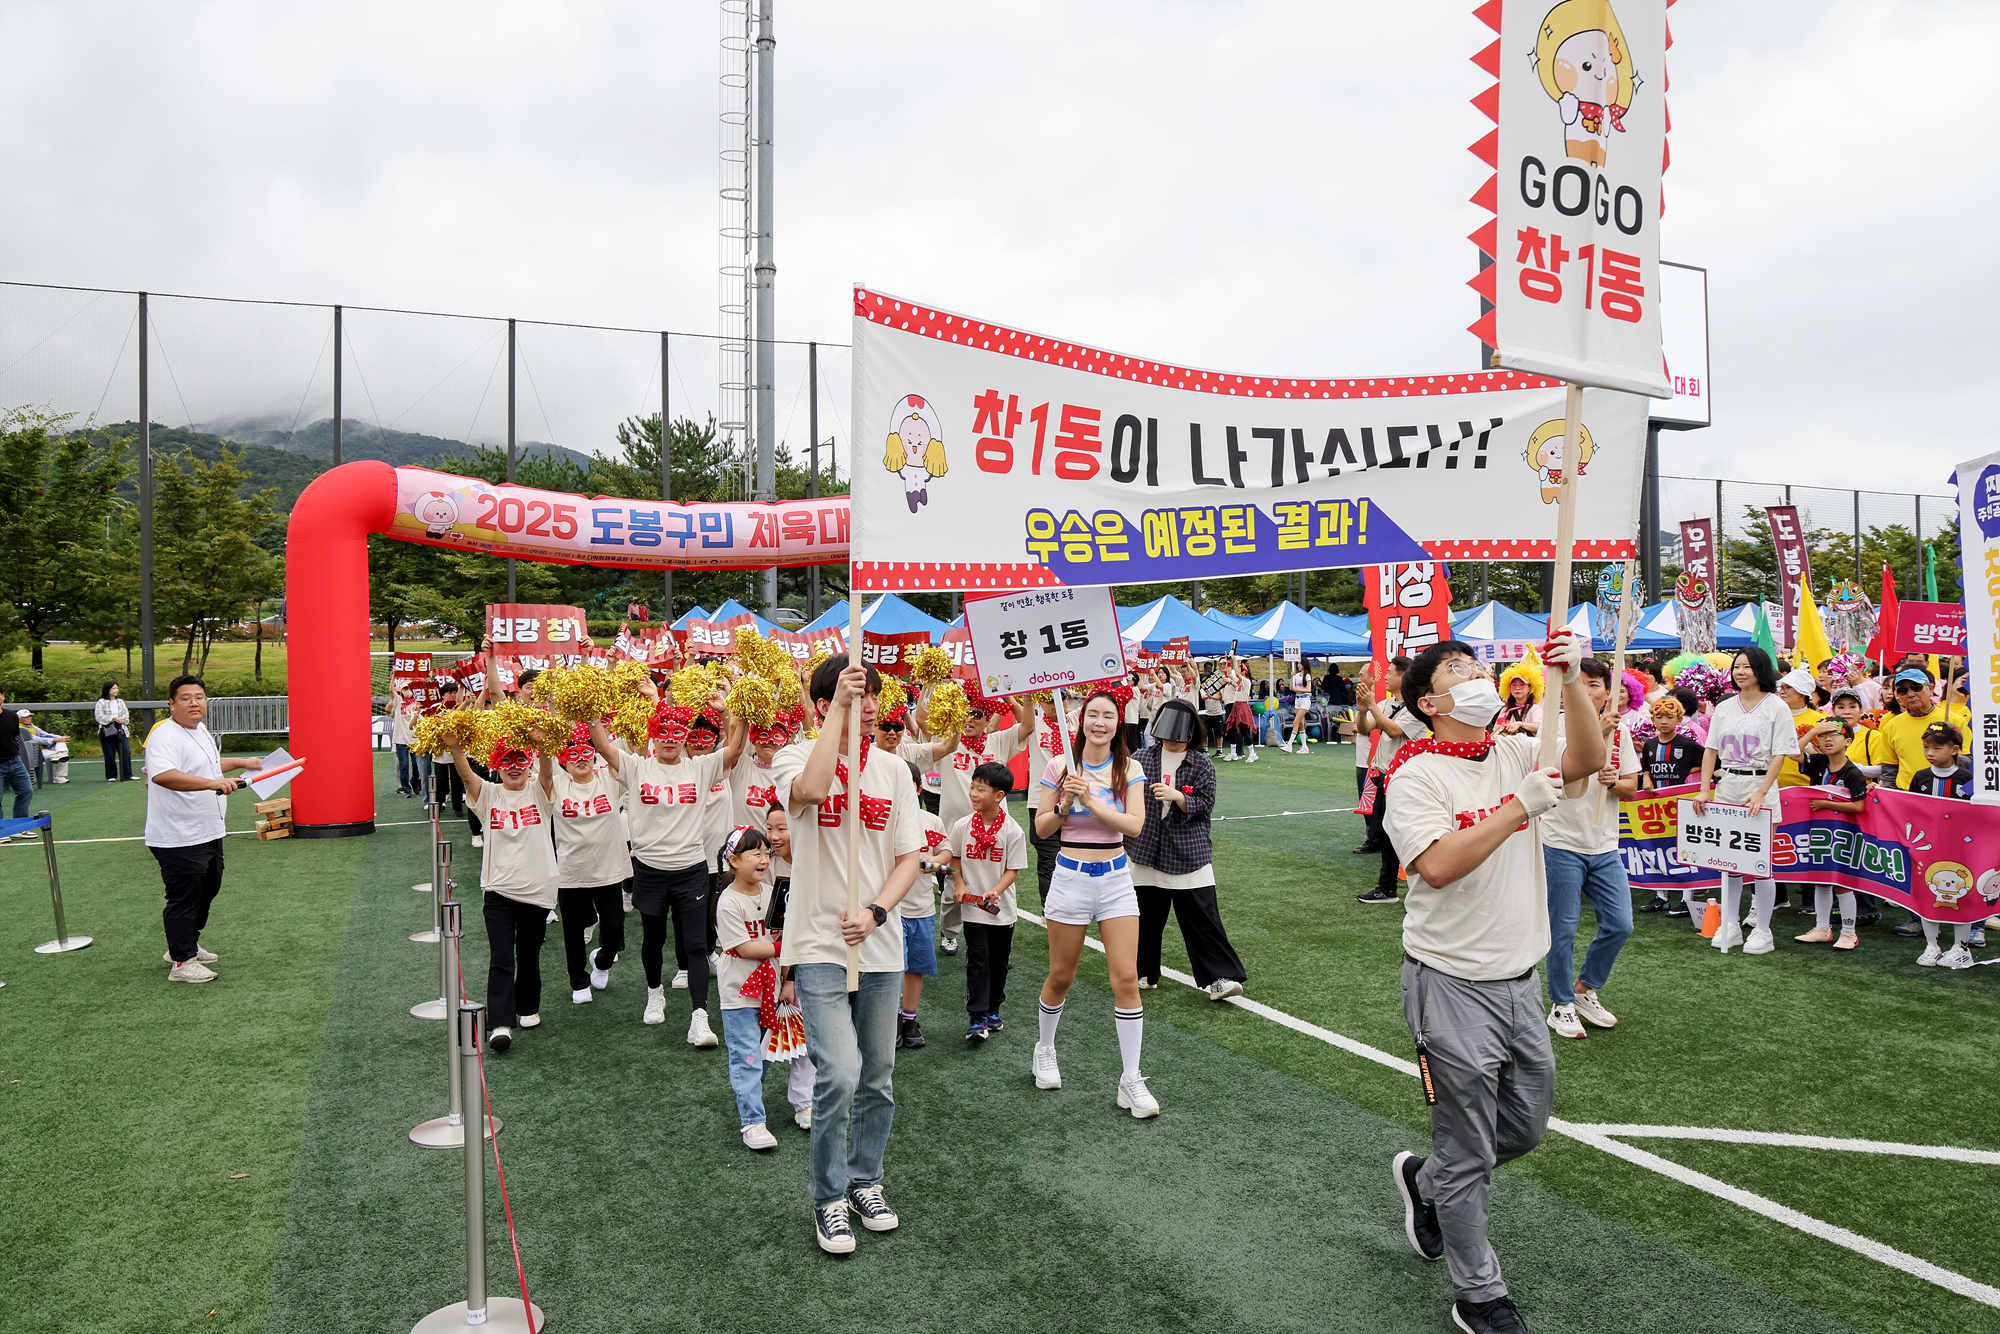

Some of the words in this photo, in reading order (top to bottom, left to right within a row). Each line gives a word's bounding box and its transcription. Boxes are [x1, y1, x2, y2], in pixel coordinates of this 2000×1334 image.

[1520, 155, 1643, 236] GOGO
[1516, 225, 1645, 324] 창1동
[1674, 375, 1700, 397] 대회
[971, 388, 1159, 487] 창1동이
[475, 493, 579, 540] 2025
[590, 507, 734, 549] 도봉구민
[748, 507, 850, 548] 체육대
[1026, 511, 1130, 563] 우승은
[1142, 507, 1256, 558] 예정된
[1274, 500, 1369, 550] 결과!
[1061, 588, 1074, 601] 도봉
[491, 617, 541, 643] 최강
[692, 625, 731, 646] 최강
[999, 630, 1028, 660] 창
[1039, 618, 1090, 654] 1동
[394, 658, 415, 672] 최강
[862, 641, 900, 665] 최강
[1029, 670, 1076, 685] dobong
[562, 793, 613, 819] 창1동
[640, 782, 697, 805] 창1동
[490, 804, 542, 830] 창1동
[1685, 823, 1722, 848] 방학
[1729, 830, 1762, 854] 2동
[1707, 856, 1738, 870] dobong
